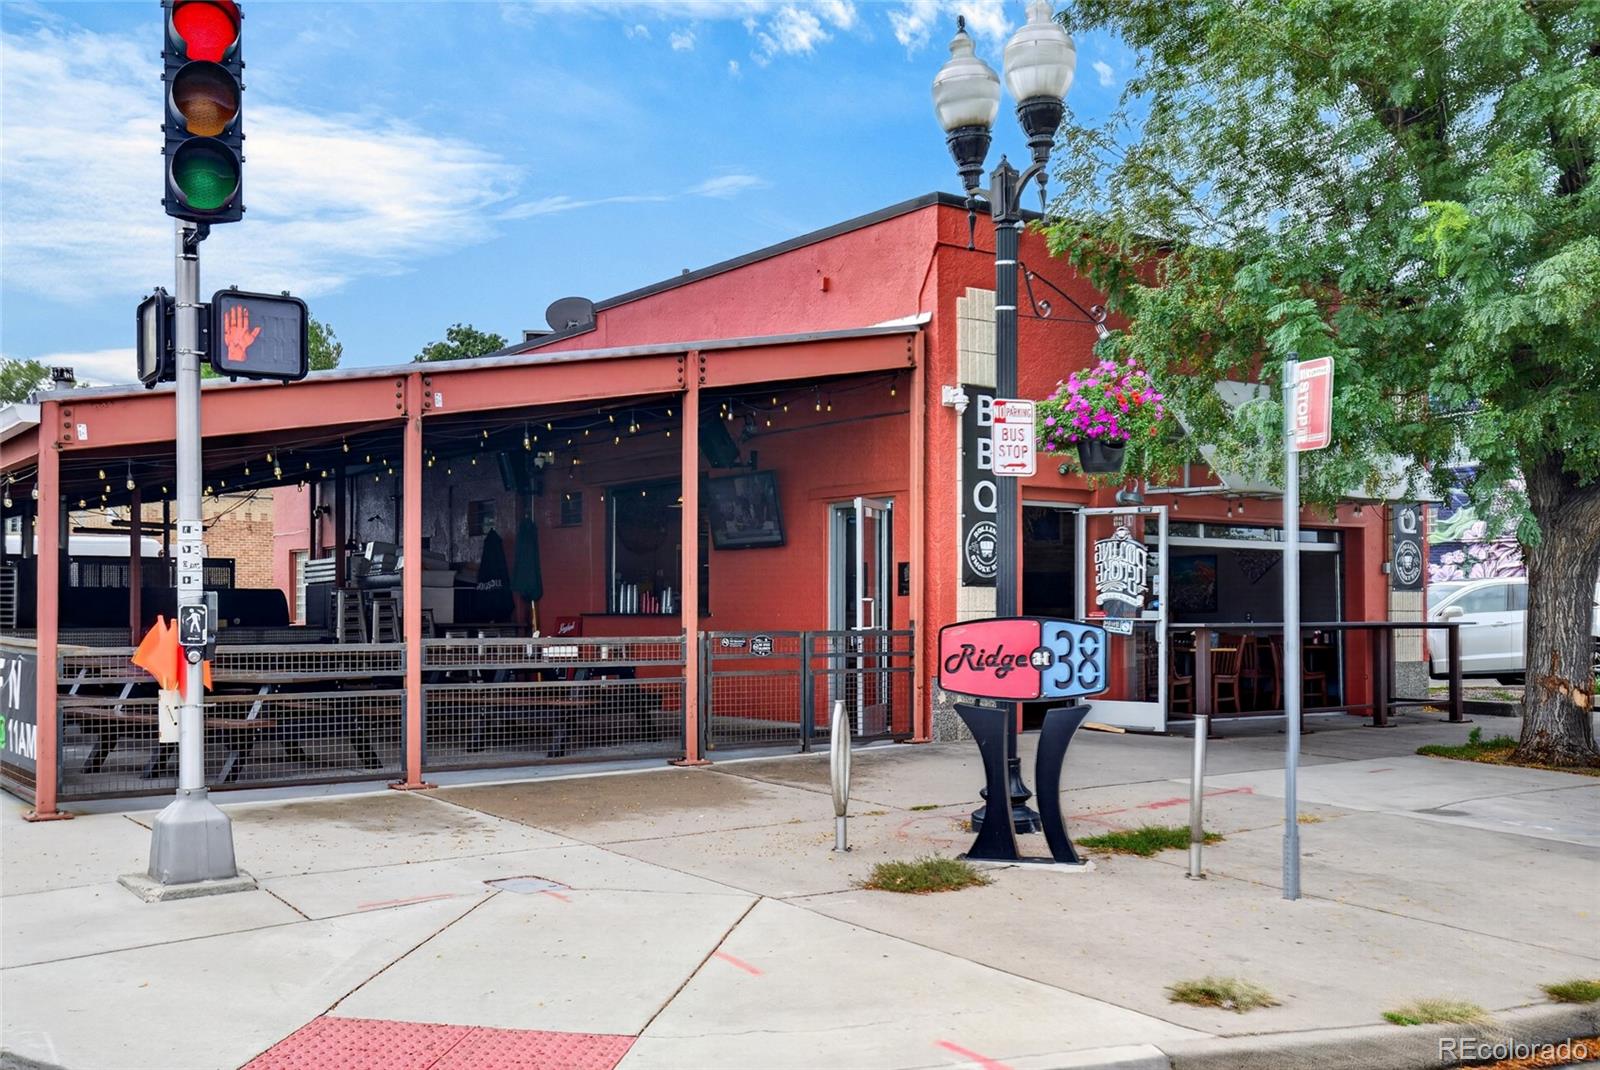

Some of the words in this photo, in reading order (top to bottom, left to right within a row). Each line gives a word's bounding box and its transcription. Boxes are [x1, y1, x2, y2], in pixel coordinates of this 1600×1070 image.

[1006, 408, 1031, 418] PARKING
[1002, 428, 1024, 442] BUS
[999, 445, 1028, 459] STOP
[944, 643, 1028, 679] Ridge
[1032, 652, 1051, 667] at
[1054, 629, 1100, 690] 38
